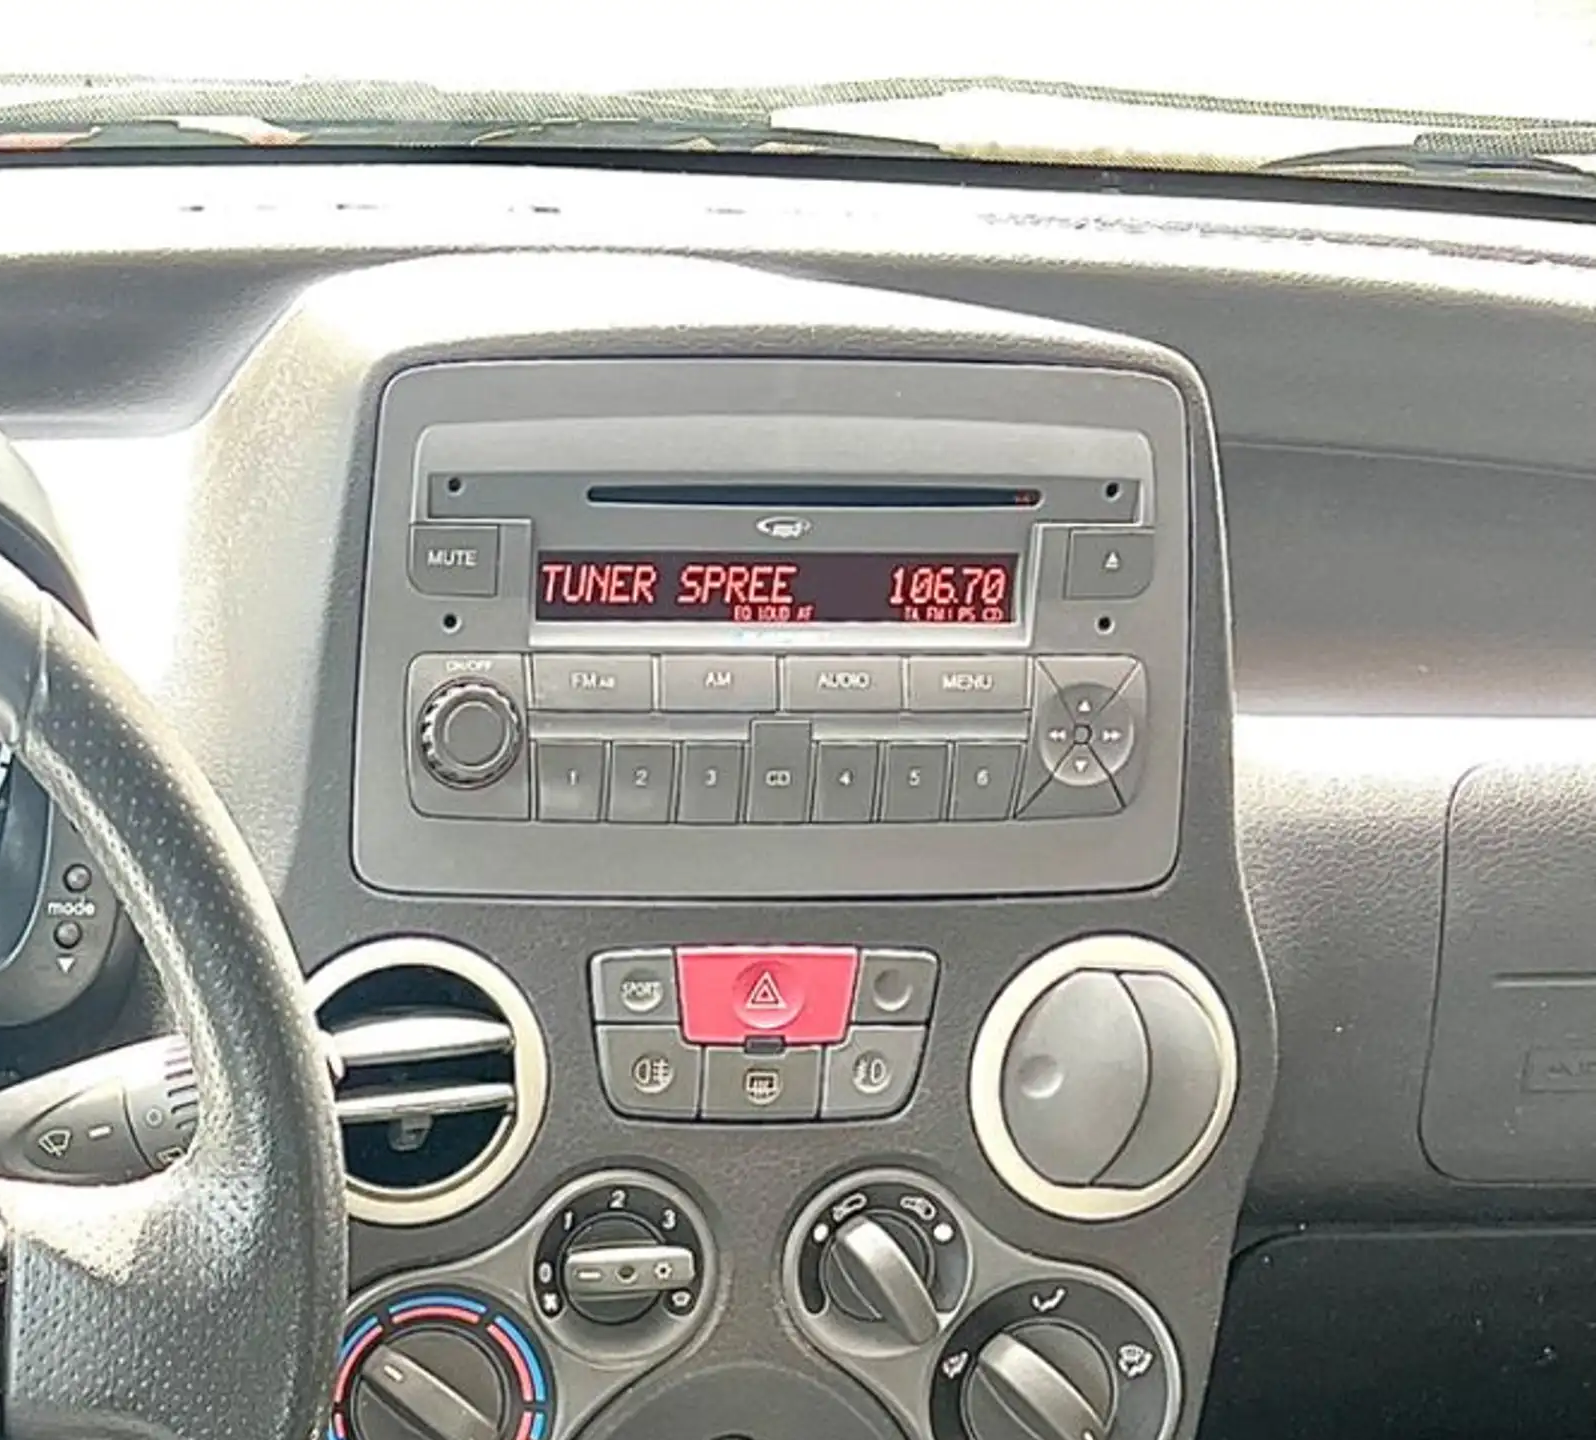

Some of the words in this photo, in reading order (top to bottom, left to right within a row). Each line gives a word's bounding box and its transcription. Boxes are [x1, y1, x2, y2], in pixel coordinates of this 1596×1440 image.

[426, 548, 478, 567] MUTE
[541, 564, 657, 604] TUNER
[676, 564, 798, 604] SPREE
[889, 566, 1006, 604] 106.70
[570, 671, 597, 690] FM
[704, 671, 732, 689] AM
[817, 671, 871, 690] AUDIO
[941, 674, 994, 691] MENU
[567, 769, 579, 786] 1
[634, 769, 649, 787] 2
[705, 768, 718, 787] 3
[765, 769, 792, 787] CD
[838, 769, 854, 786] 4
[908, 768, 922, 786] 5
[975, 768, 990, 787] 6
[47, 896, 96, 917] mode
[609, 1189, 626, 1209] 2
[563, 1210, 574, 1231] 1
[661, 1208, 677, 1230] 3
[538, 1261, 553, 1284] 0
